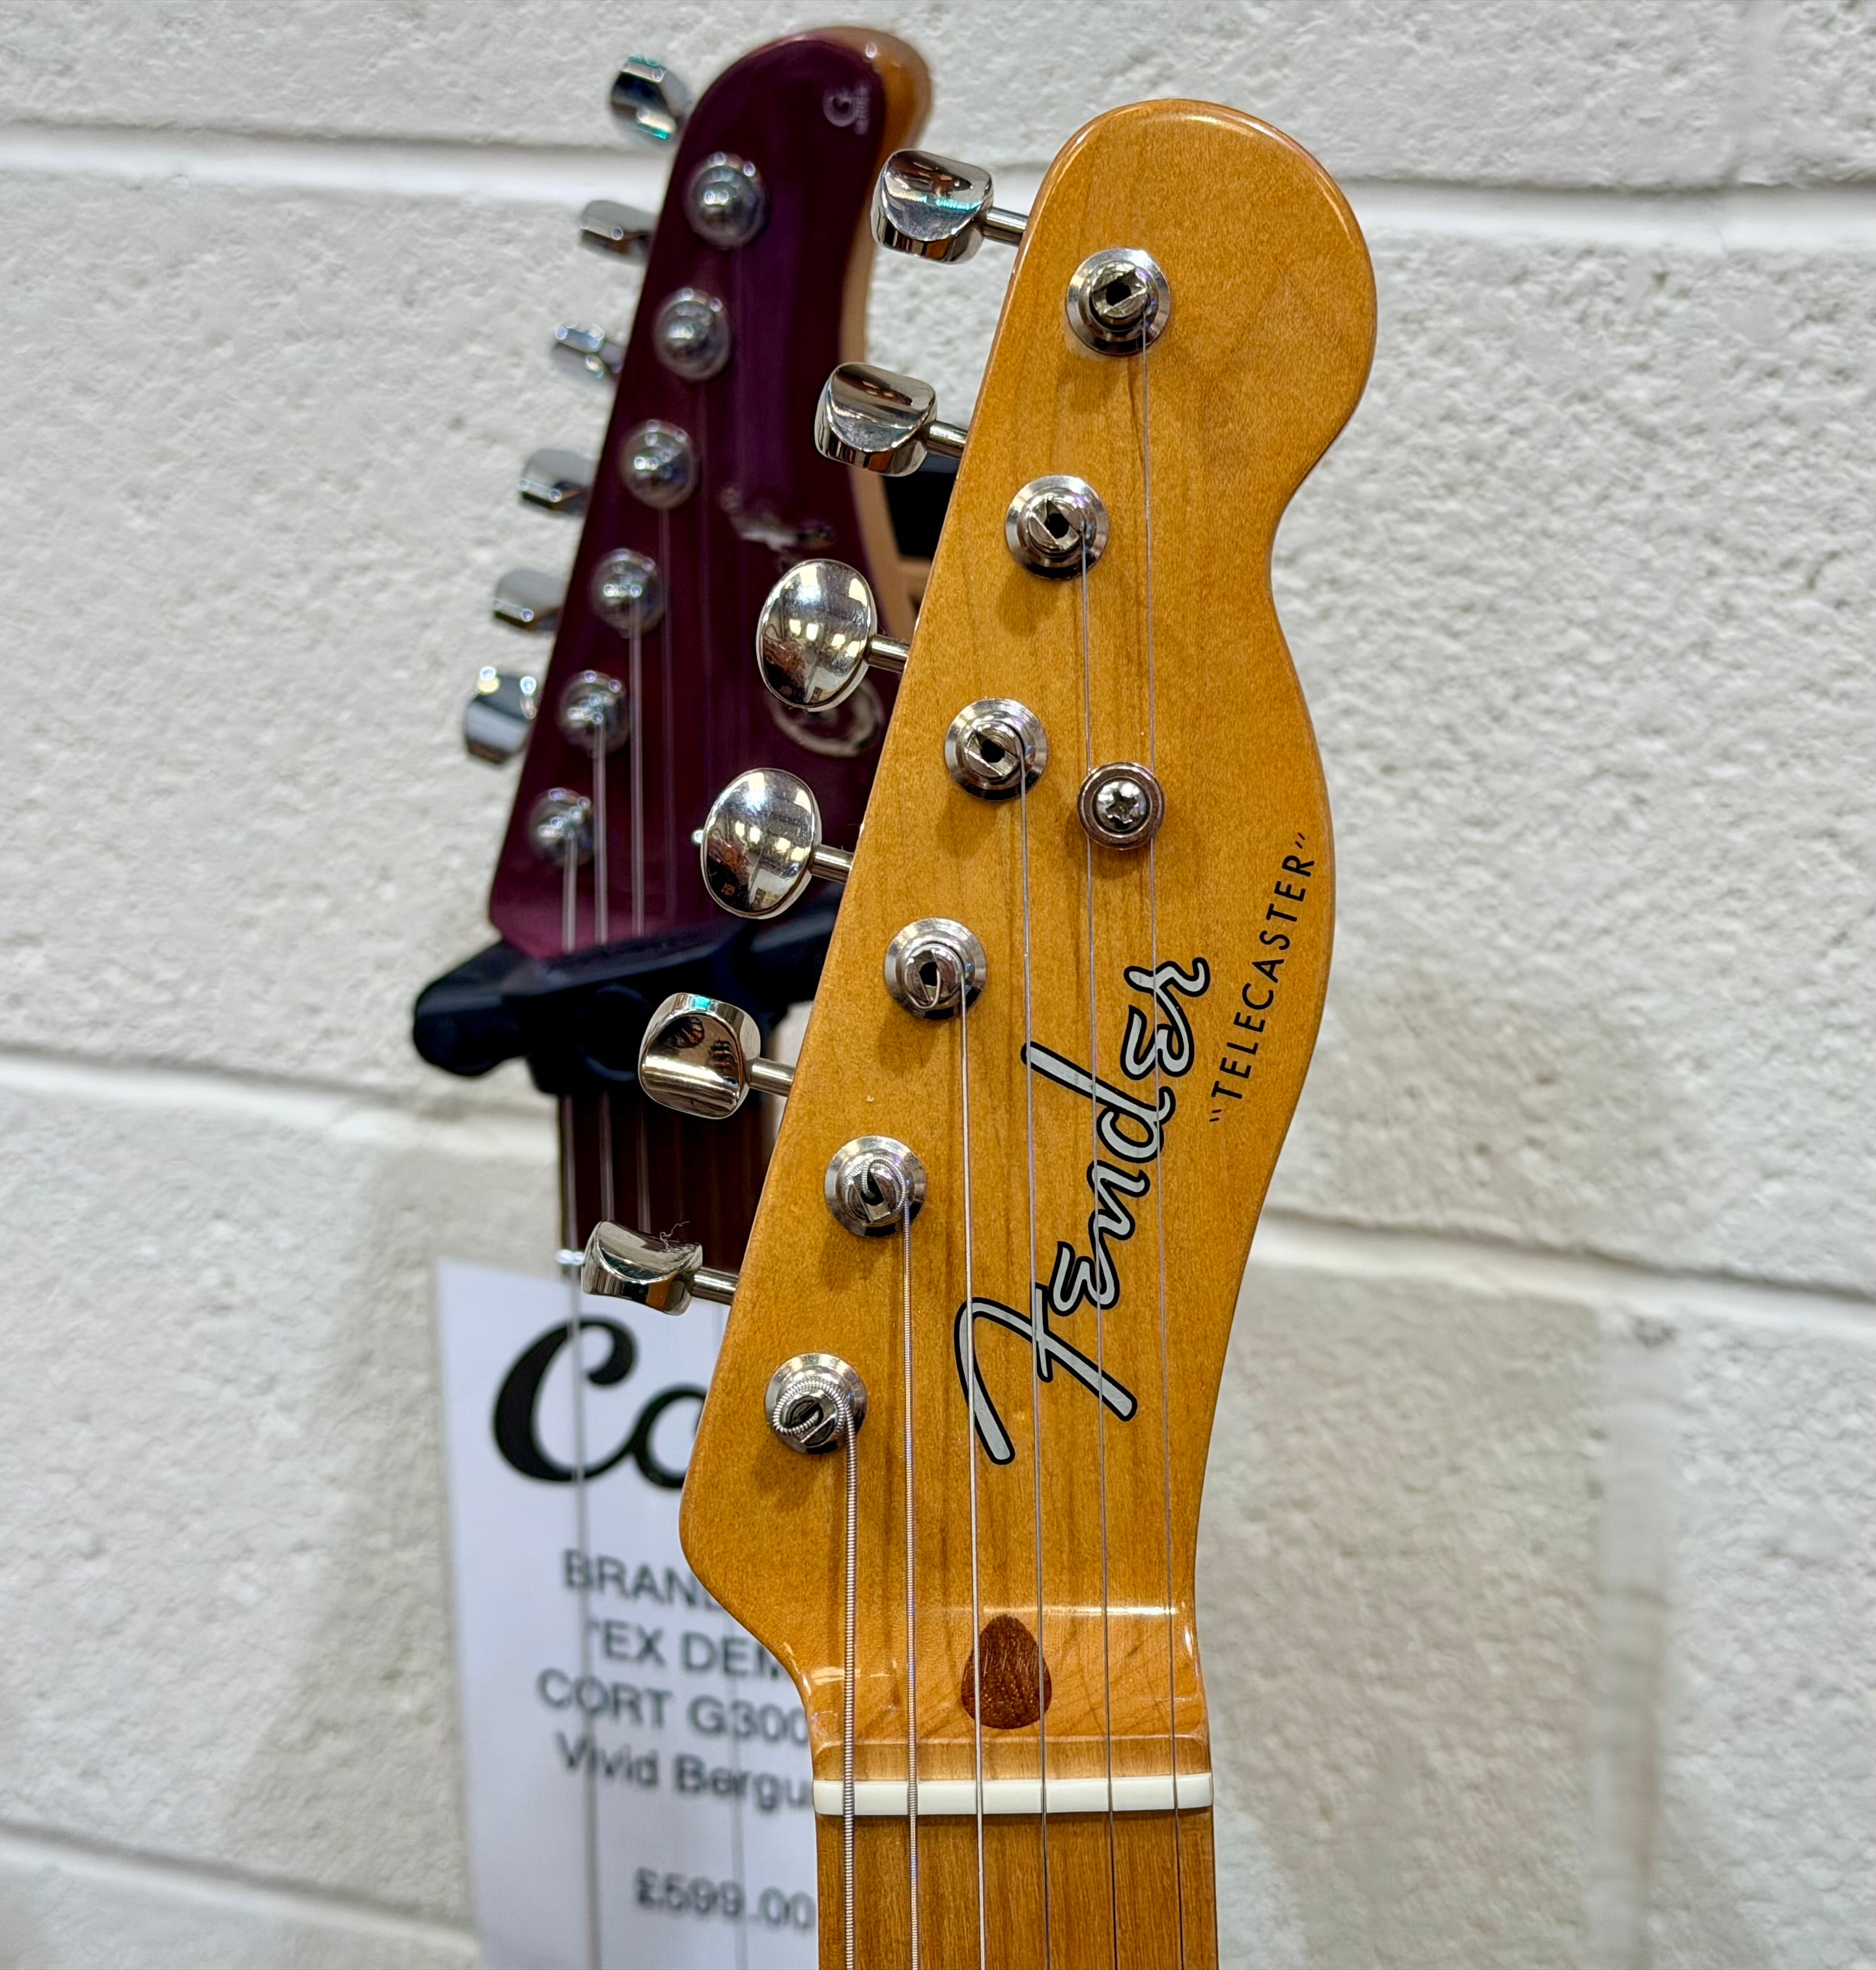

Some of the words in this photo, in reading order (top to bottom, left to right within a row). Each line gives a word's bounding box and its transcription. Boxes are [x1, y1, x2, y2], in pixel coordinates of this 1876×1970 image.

[1210, 833, 1315, 1122] "TELECASTER"
[954, 956, 1210, 1464] Fender
[537, 1668, 670, 1728] CORT
[556, 1731, 659, 1788] Vivid
